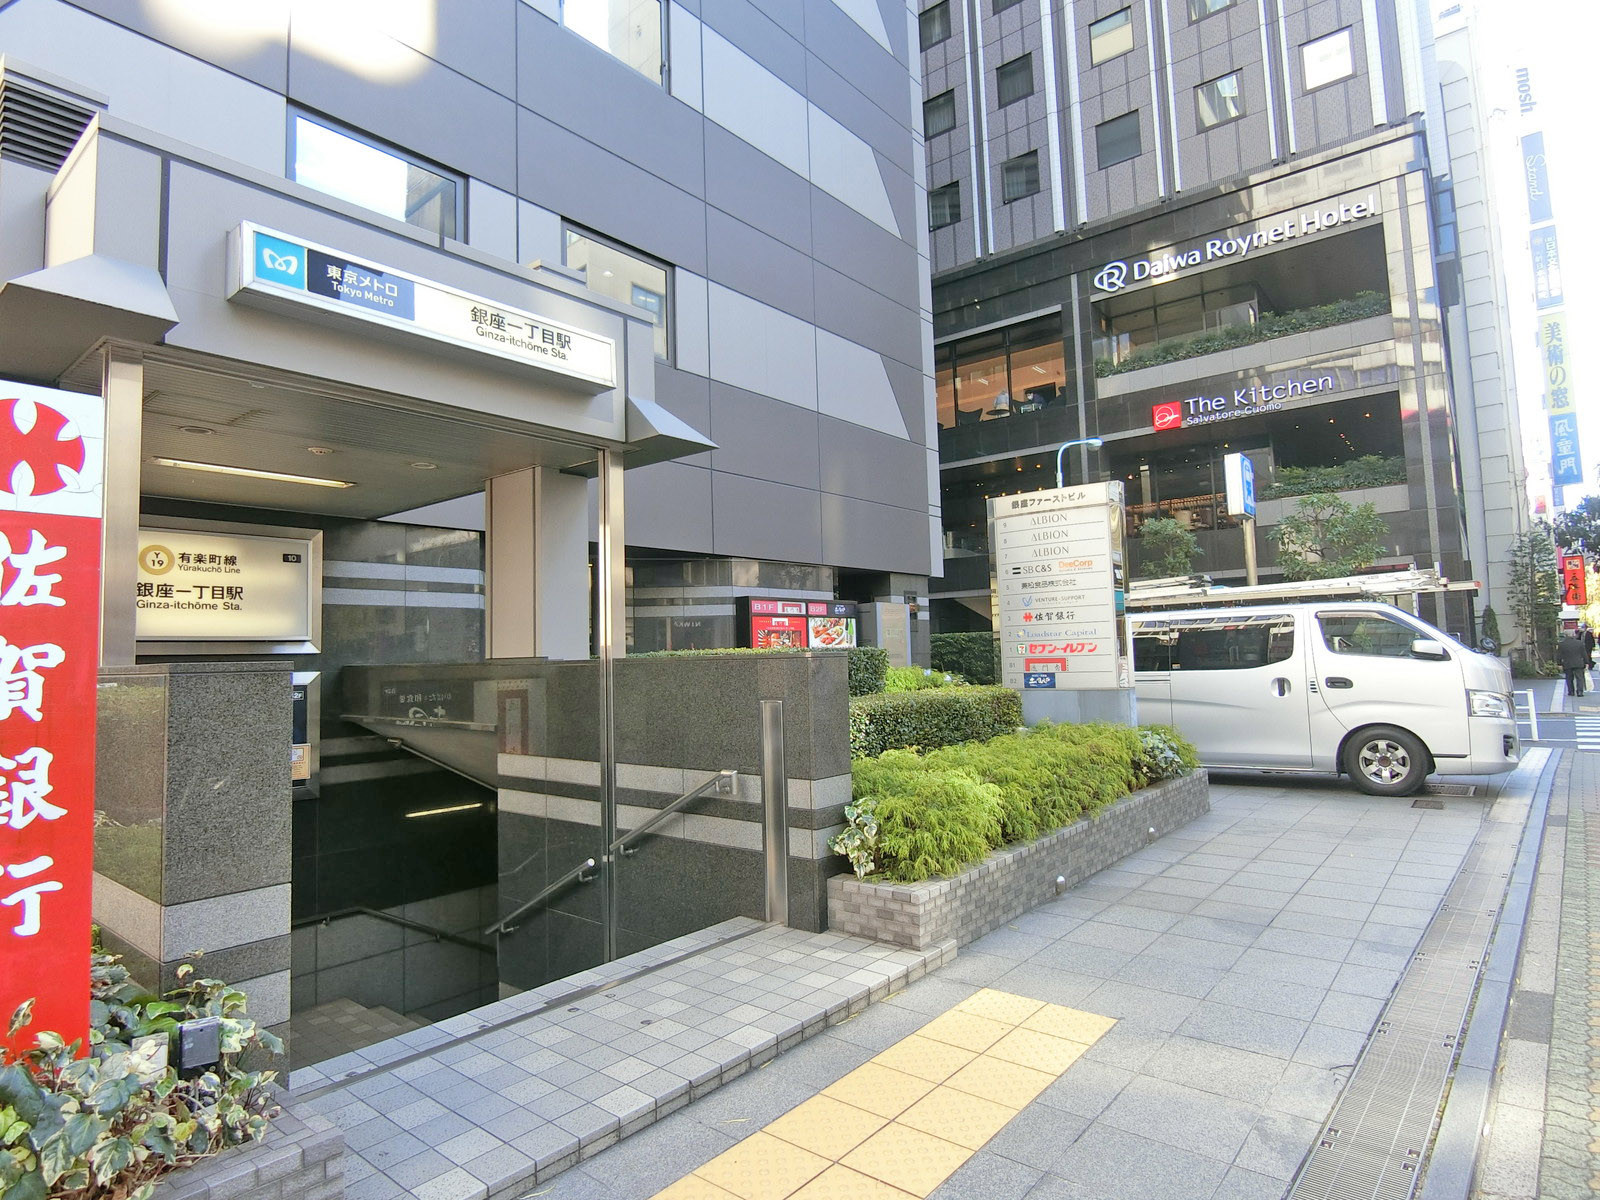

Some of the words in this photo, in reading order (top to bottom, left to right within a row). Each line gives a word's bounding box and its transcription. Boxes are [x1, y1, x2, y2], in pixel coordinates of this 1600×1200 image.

[1133, 249, 1201, 281] Daiwa
[1206, 220, 1295, 261] Roynet
[1301, 194, 1375, 234] Hotel
[326, 264, 398, 297] 東京メトロ
[331, 281, 362, 299] Tokyo
[364, 289, 394, 307] Metro
[470, 306, 572, 351] 銀座一丁目駅
[550, 346, 569, 361] Sta.
[1544, 322, 1569, 409] 美術の窓
[1184, 396, 1225, 415] The
[1234, 375, 1333, 406] Kitchen
[1186, 410, 1241, 425] Salvatore
[1011, 492, 1086, 510] 銀座ファーストビル
[1031, 514, 1068, 525] ALBION
[1031, 530, 1069, 542] ALBION
[178, 552, 238, 567] 有楽町線
[1032, 546, 1069, 558] ALBION
[151, 559, 164, 567] 19
[224, 566, 241, 574] Line
[1022, 566, 1034, 574] SB
[1035, 564, 1052, 573] C&S
[136, 582, 244, 601] 銀座一丁目駅
[223, 602, 243, 611] Sta.
[754, 603, 774, 611] B1F
[1035, 611, 1076, 621] 佐賀銀行
[1065, 628, 1097, 637] Capital
[0, 529, 68, 937] 佐賀銀行
